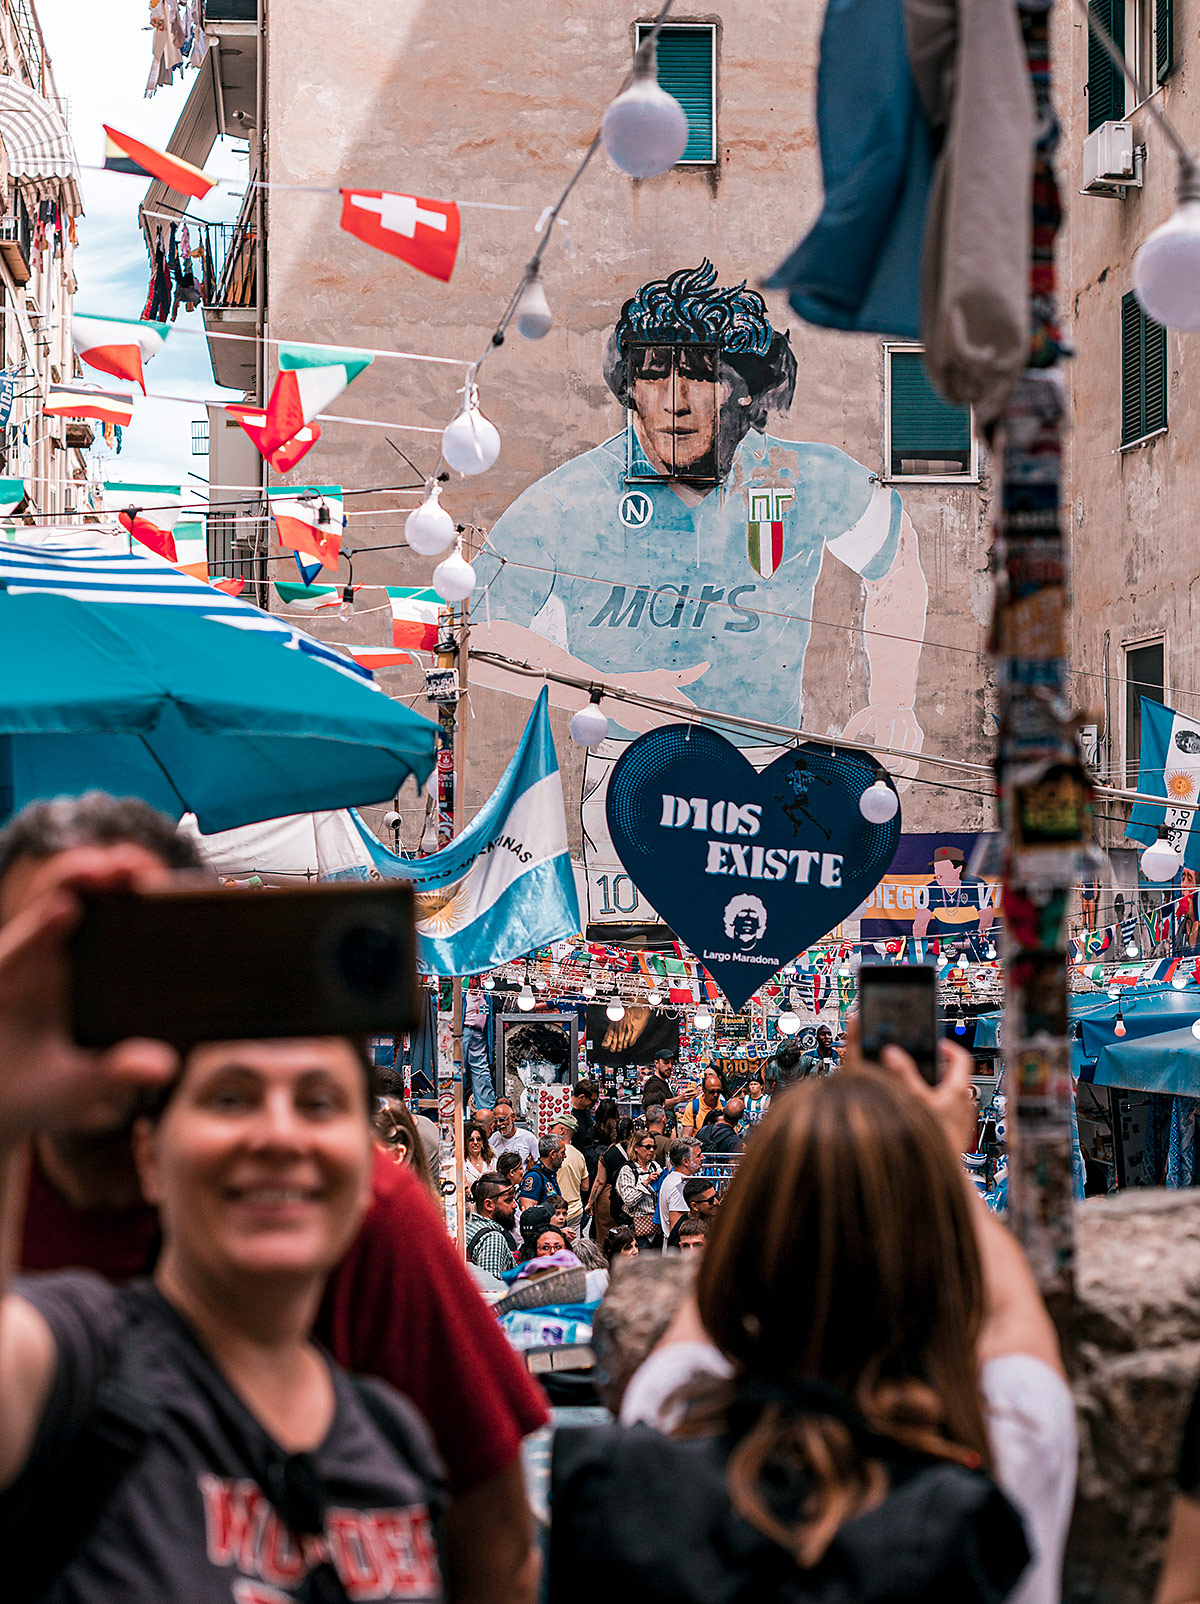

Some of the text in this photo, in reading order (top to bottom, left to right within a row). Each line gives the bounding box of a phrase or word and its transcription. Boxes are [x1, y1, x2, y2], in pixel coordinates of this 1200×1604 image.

[625, 499, 645, 522] N
[705, 841, 844, 889] EXISTE
[596, 874, 639, 914] 10
[703, 949, 780, 966] Largo Maradona
[197, 1472, 443, 1601] WODE
